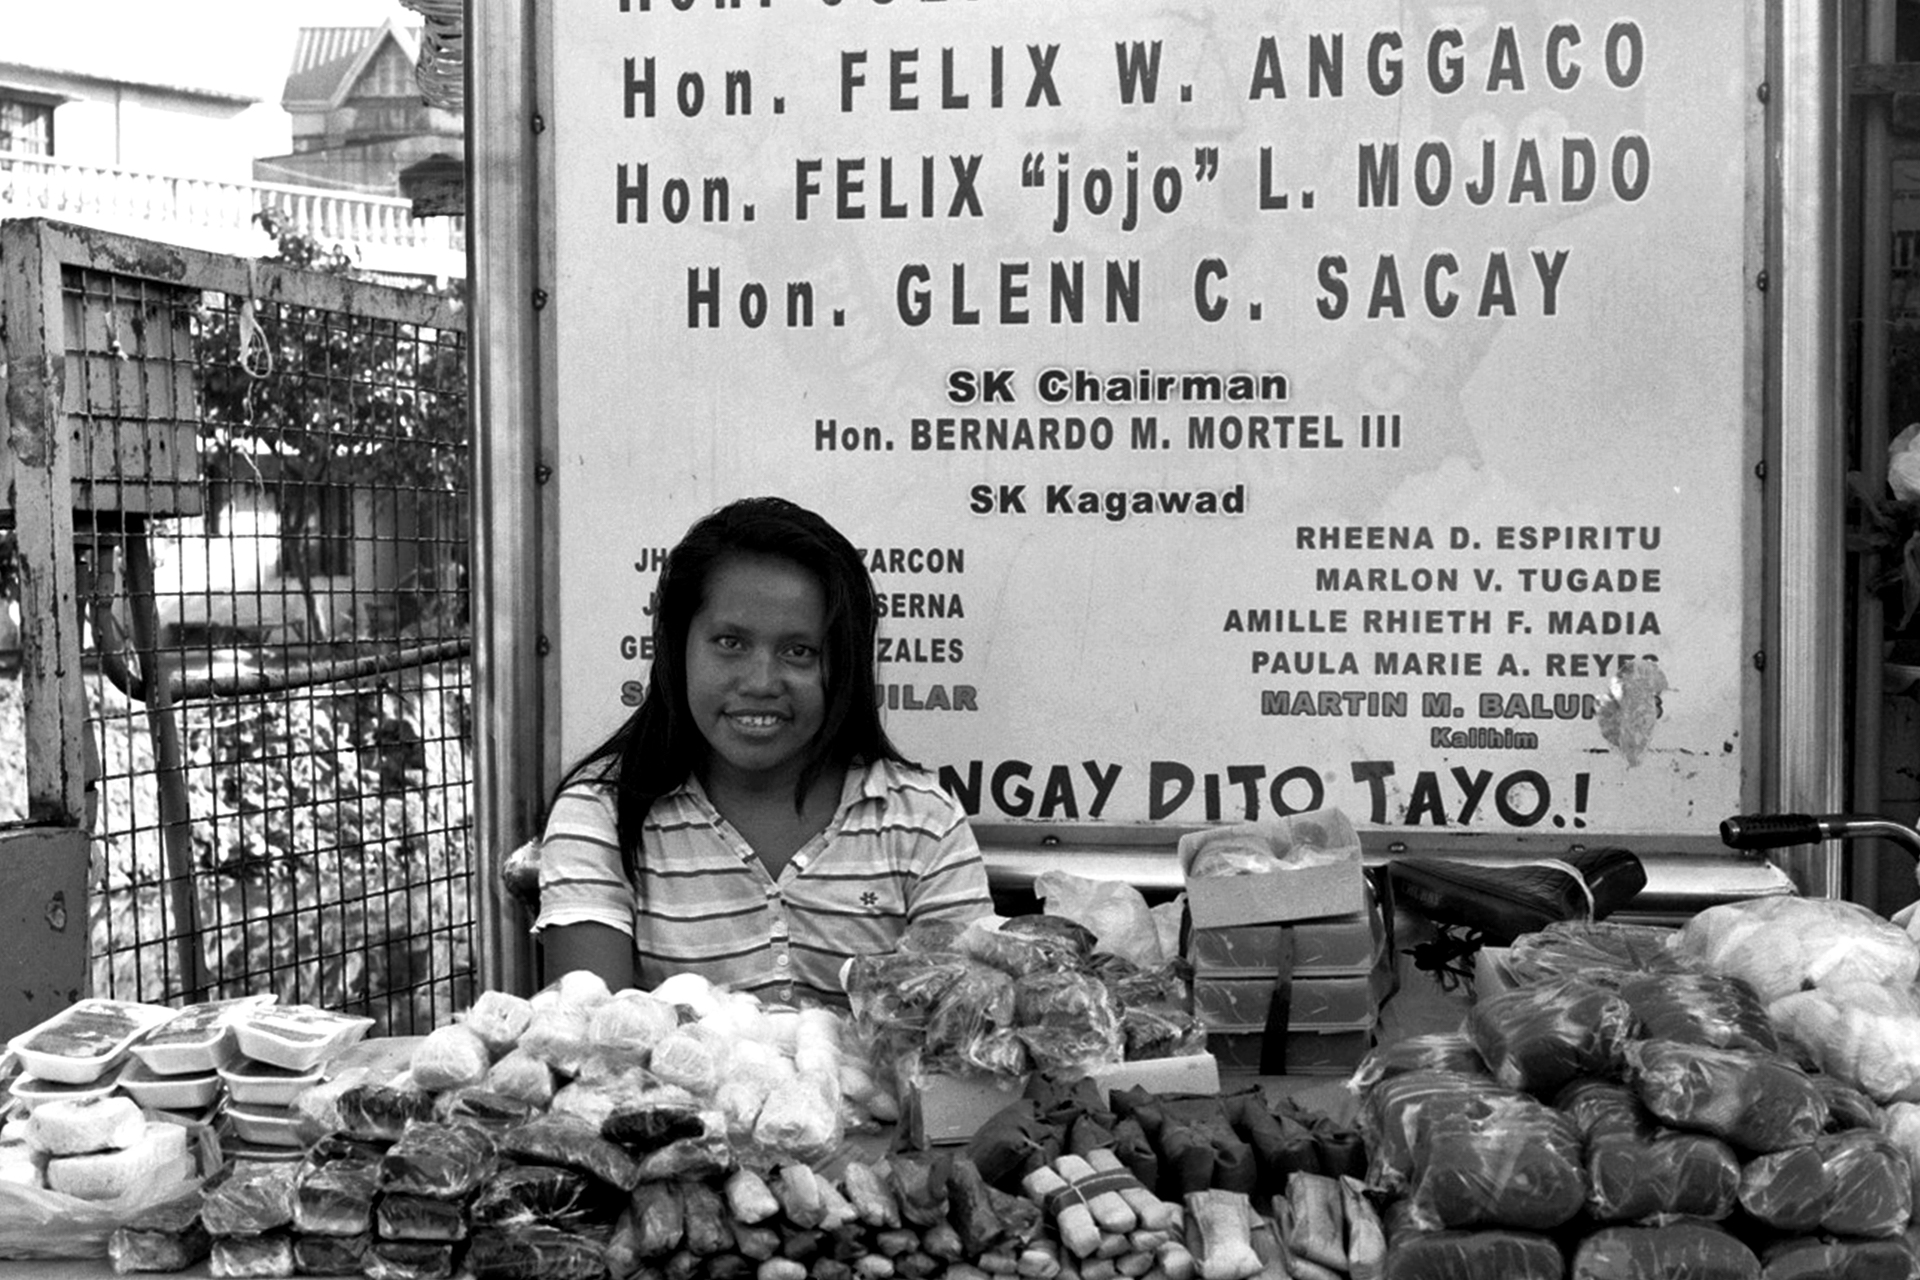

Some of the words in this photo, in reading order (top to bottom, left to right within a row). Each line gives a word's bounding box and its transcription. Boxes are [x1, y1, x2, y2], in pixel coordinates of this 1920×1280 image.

[624, 57, 784, 118] Hon.
[841, 44, 1061, 112] FELIX
[1116, 40, 1192, 104] W.
[1249, 22, 1642, 100] ANGGACO
[617, 163, 754, 224] Hon.
[796, 155, 983, 220] FELIX
[1260, 147, 1313, 210] L.
[1359, 136, 1649, 207] MOJADO
[688, 267, 844, 328] Hon.
[897, 260, 1139, 326] GLENN
[1195, 259, 1261, 322] C.
[1317, 251, 1569, 320] SACAY
[949, 371, 1014, 402] SK
[1039, 370, 1286, 401] Chairman
[816, 420, 893, 451] Hon.
[912, 417, 1113, 450] BERNARDO
[1132, 417, 1169, 449] M.
[1189, 416, 1343, 449] MORTEL
[1362, 415, 1400, 448] III
[971, 485, 1026, 513] SK
[1047, 485, 1243, 521] Kagawad
[1297, 527, 1433, 549] RHEENA
[1451, 527, 1480, 549] D.
[1497, 526, 1660, 550] ESPIRITU
[1317, 568, 1457, 591] MARLON
[1474, 569, 1501, 591] V.
[1518, 569, 1660, 592] TUGADE
[1224, 610, 1346, 632] AMILLE
[1364, 610, 1490, 633] RHIETH
[1508, 611, 1531, 634] F.
[1549, 611, 1660, 635] MADIA
[877, 638, 964, 663] ZALES
[1252, 651, 1359, 674] PAULA
[1375, 652, 1481, 675] MARIE
[1498, 654, 1529, 676] A.
[1261, 690, 1407, 717] MARTIN
[1422, 692, 1464, 718] M.
[1431, 727, 1538, 749] Kalihim
[939, 760, 1122, 817] NGAY
[1149, 761, 1324, 822] DITO
